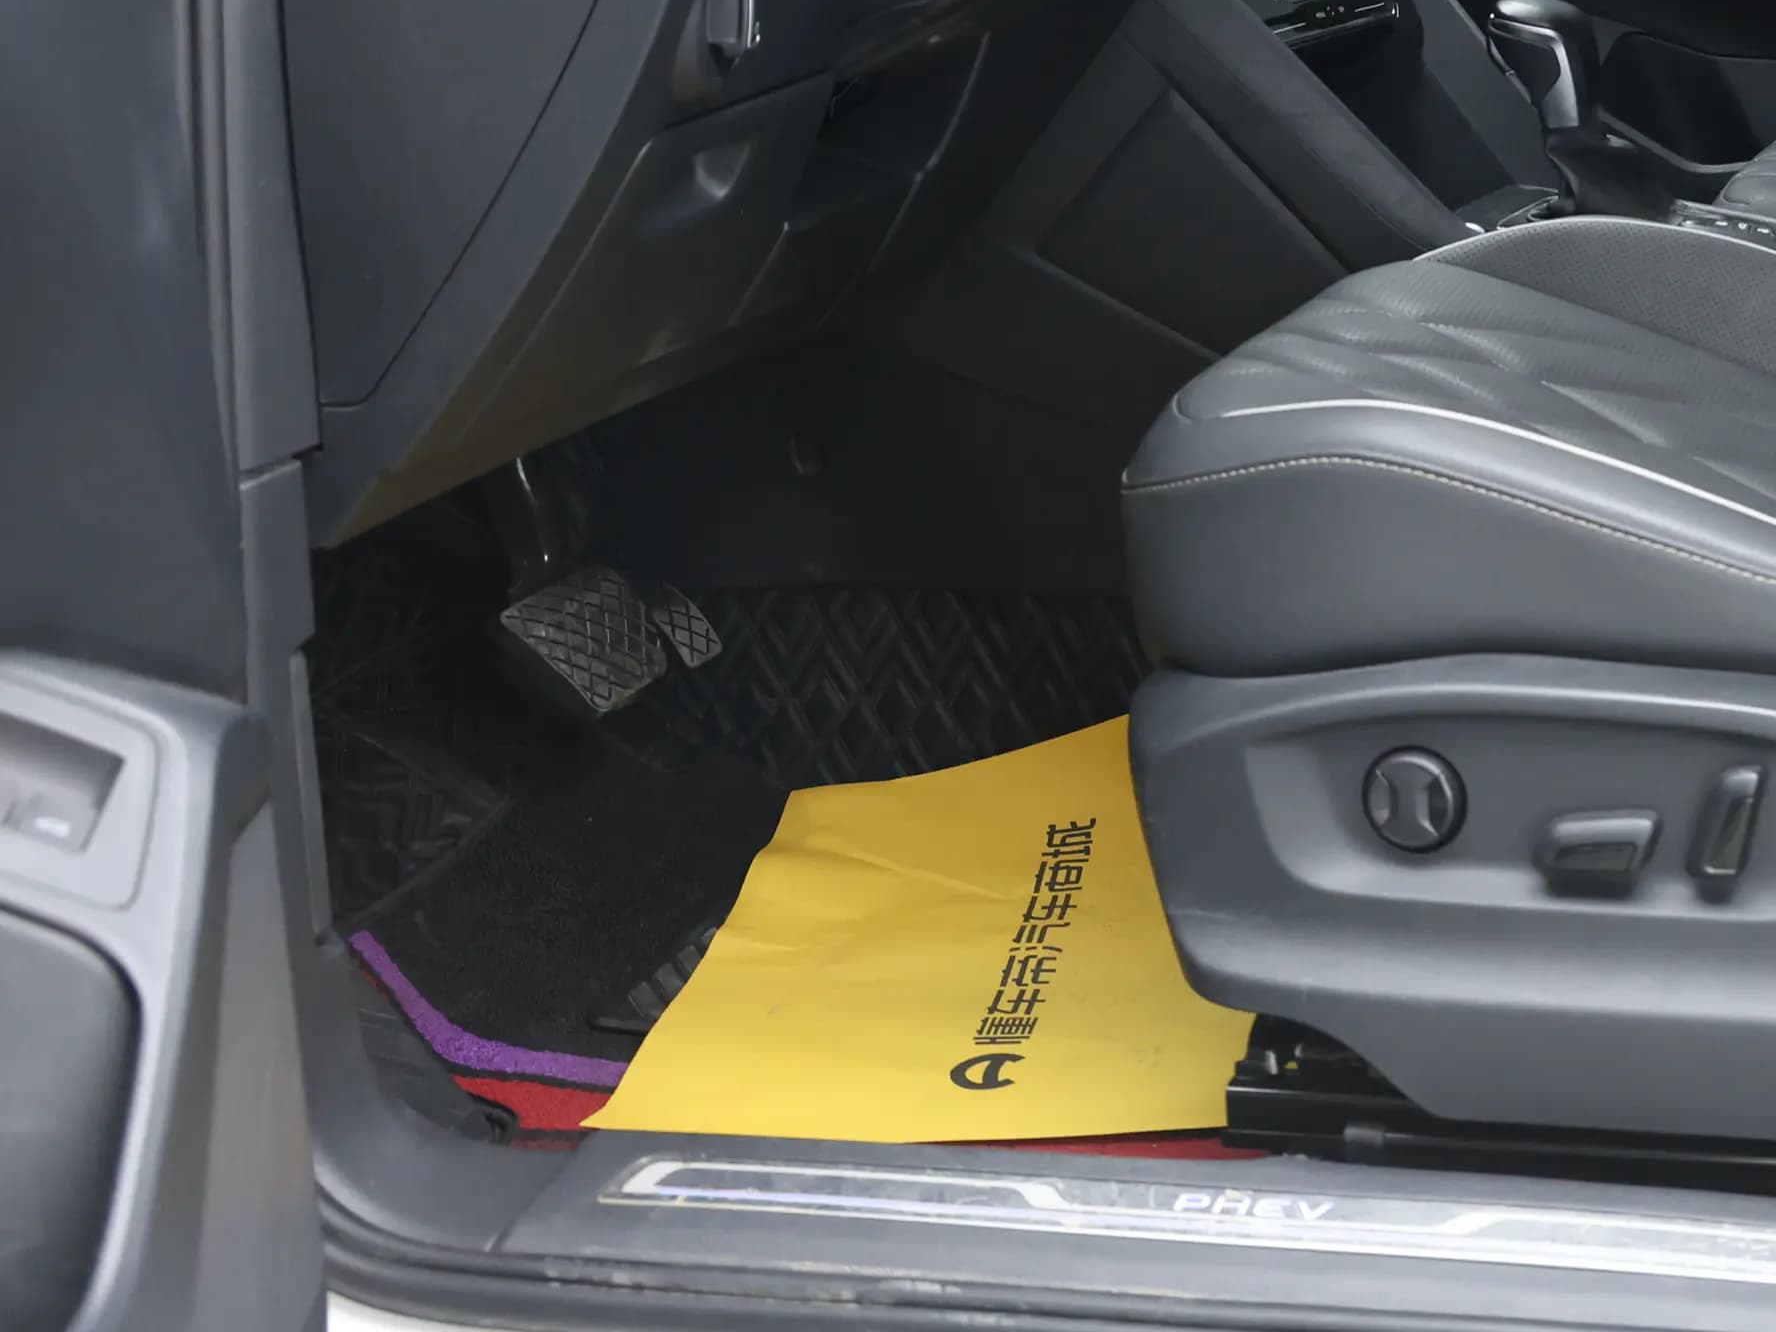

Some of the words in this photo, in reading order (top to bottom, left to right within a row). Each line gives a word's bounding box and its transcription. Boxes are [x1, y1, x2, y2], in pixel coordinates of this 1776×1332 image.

[973, 817, 1097, 1046] 懂车帝汽车商城
[1173, 1191, 1335, 1220] PHEV
